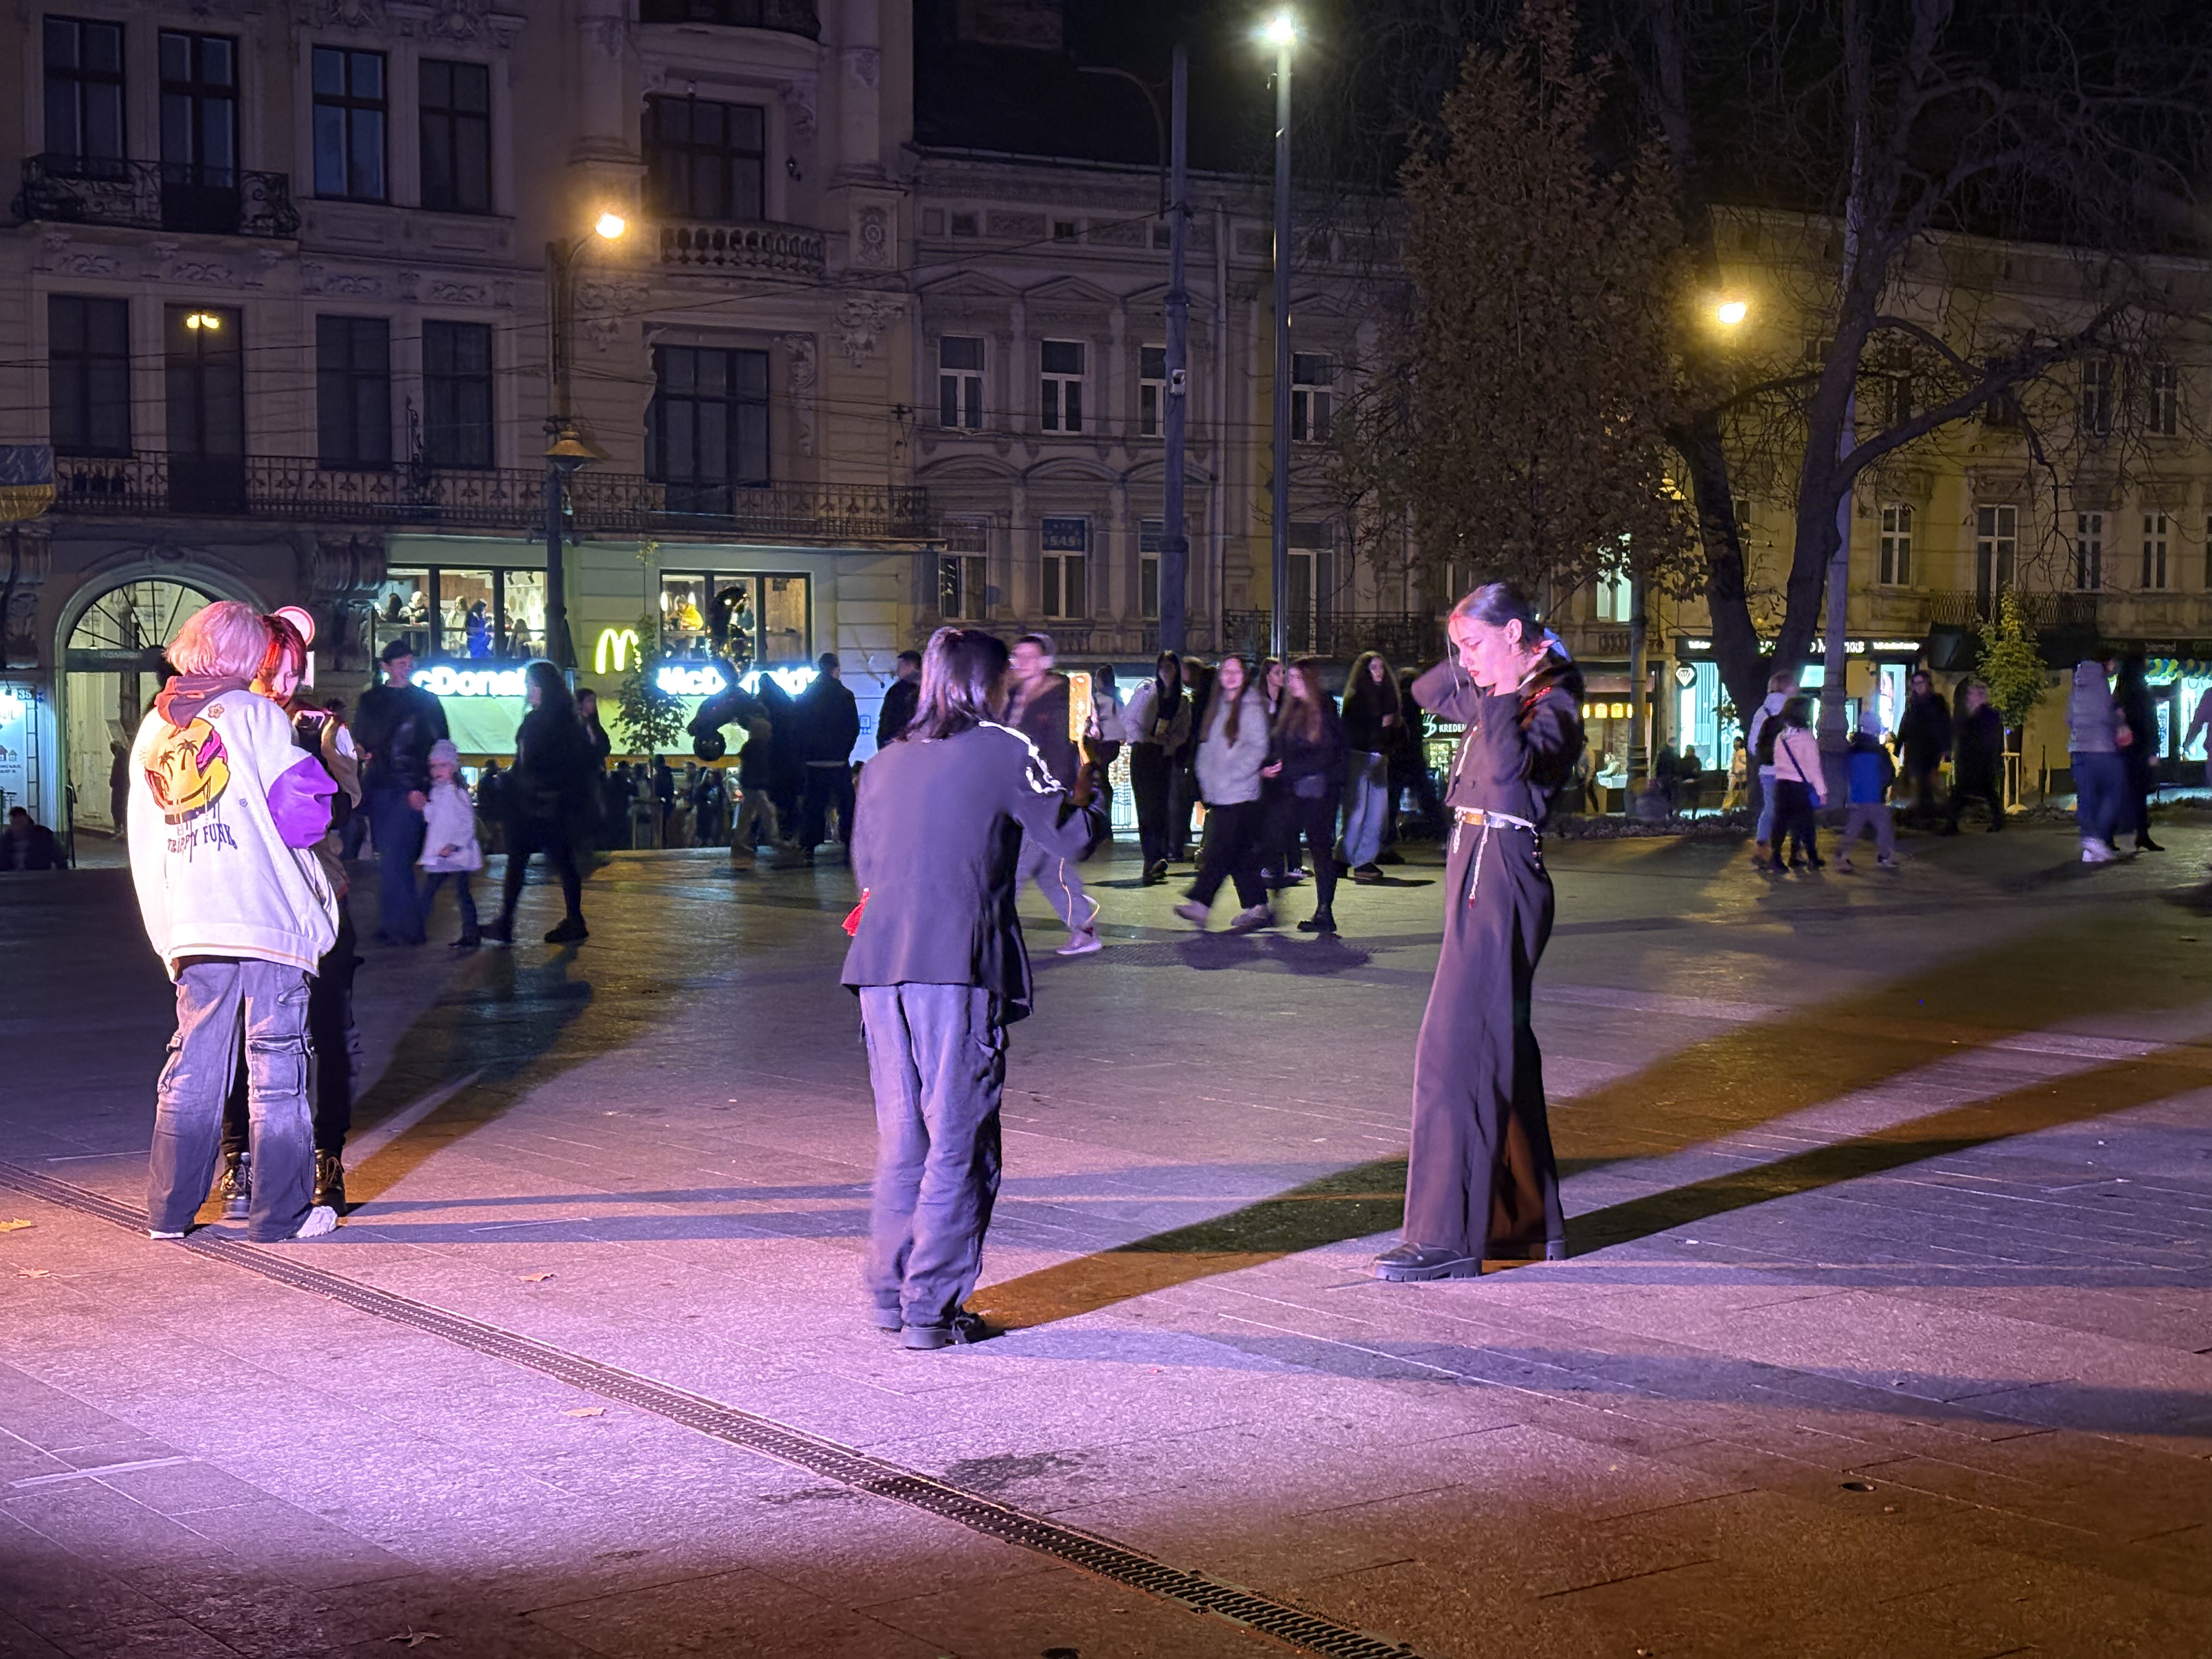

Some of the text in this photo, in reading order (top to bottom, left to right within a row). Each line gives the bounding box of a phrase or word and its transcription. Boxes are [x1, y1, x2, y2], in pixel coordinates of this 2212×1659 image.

[18, 689, 33, 700] 35
[1439, 723, 1467, 733] KREDEN
[168, 823, 238, 854] TRIPPY FUNK
